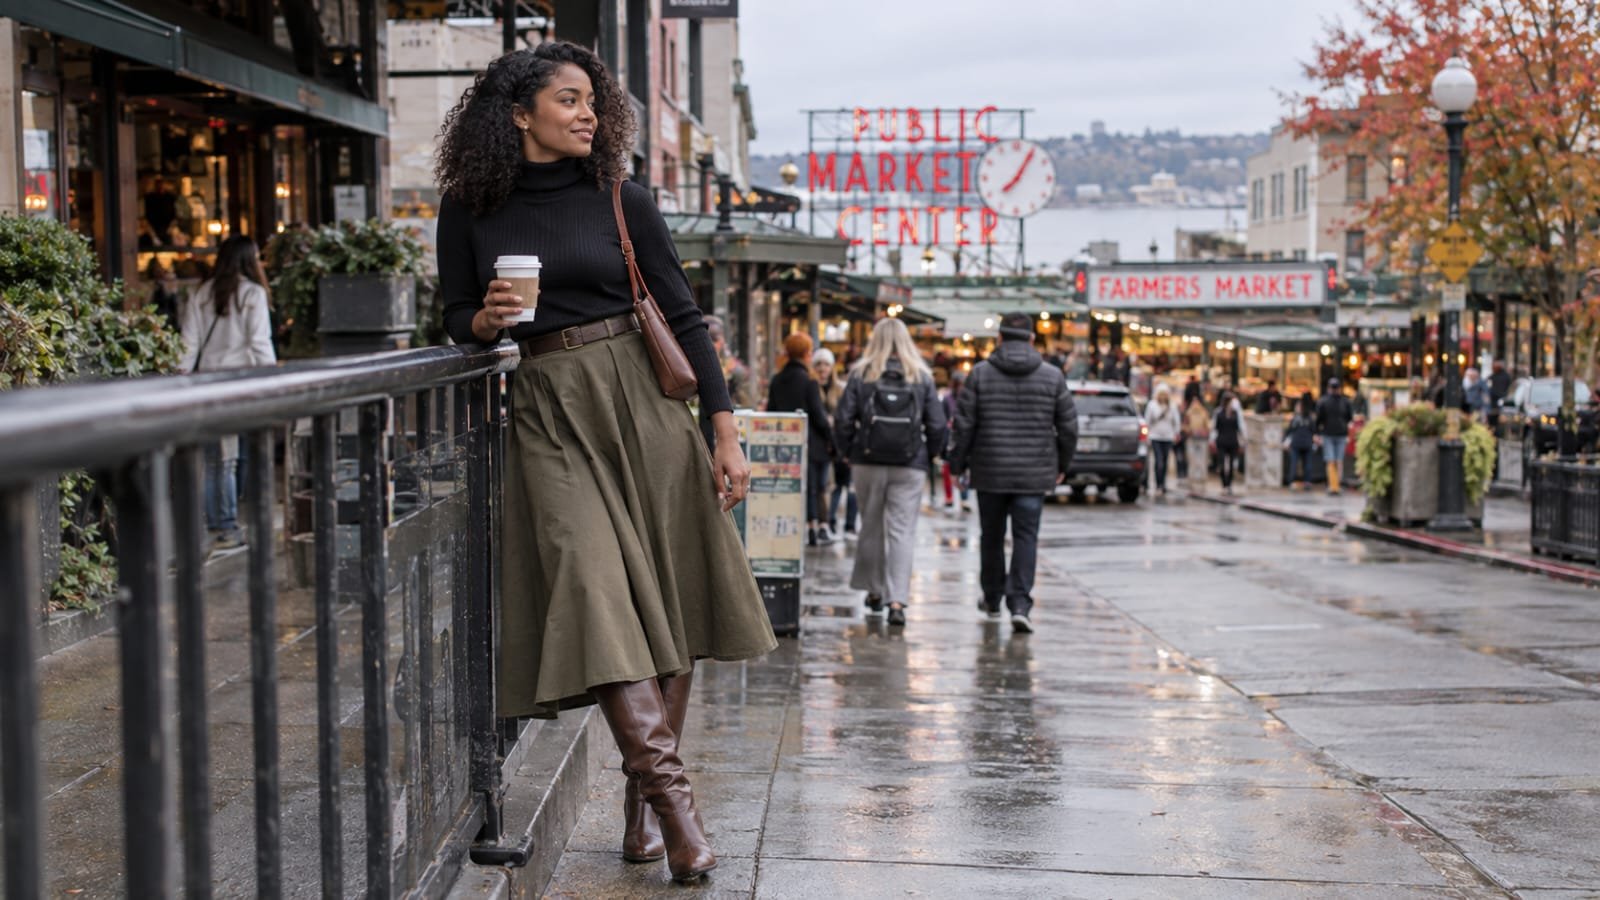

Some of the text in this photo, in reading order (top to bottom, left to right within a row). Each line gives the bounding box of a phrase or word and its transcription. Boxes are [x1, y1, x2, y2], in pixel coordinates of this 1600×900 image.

[853, 106, 998, 143] PUBLIC
[808, 152, 977, 193] MARKET
[836, 207, 998, 245] CENTER
[1098, 273, 1314, 299] FARMERS MARKET
